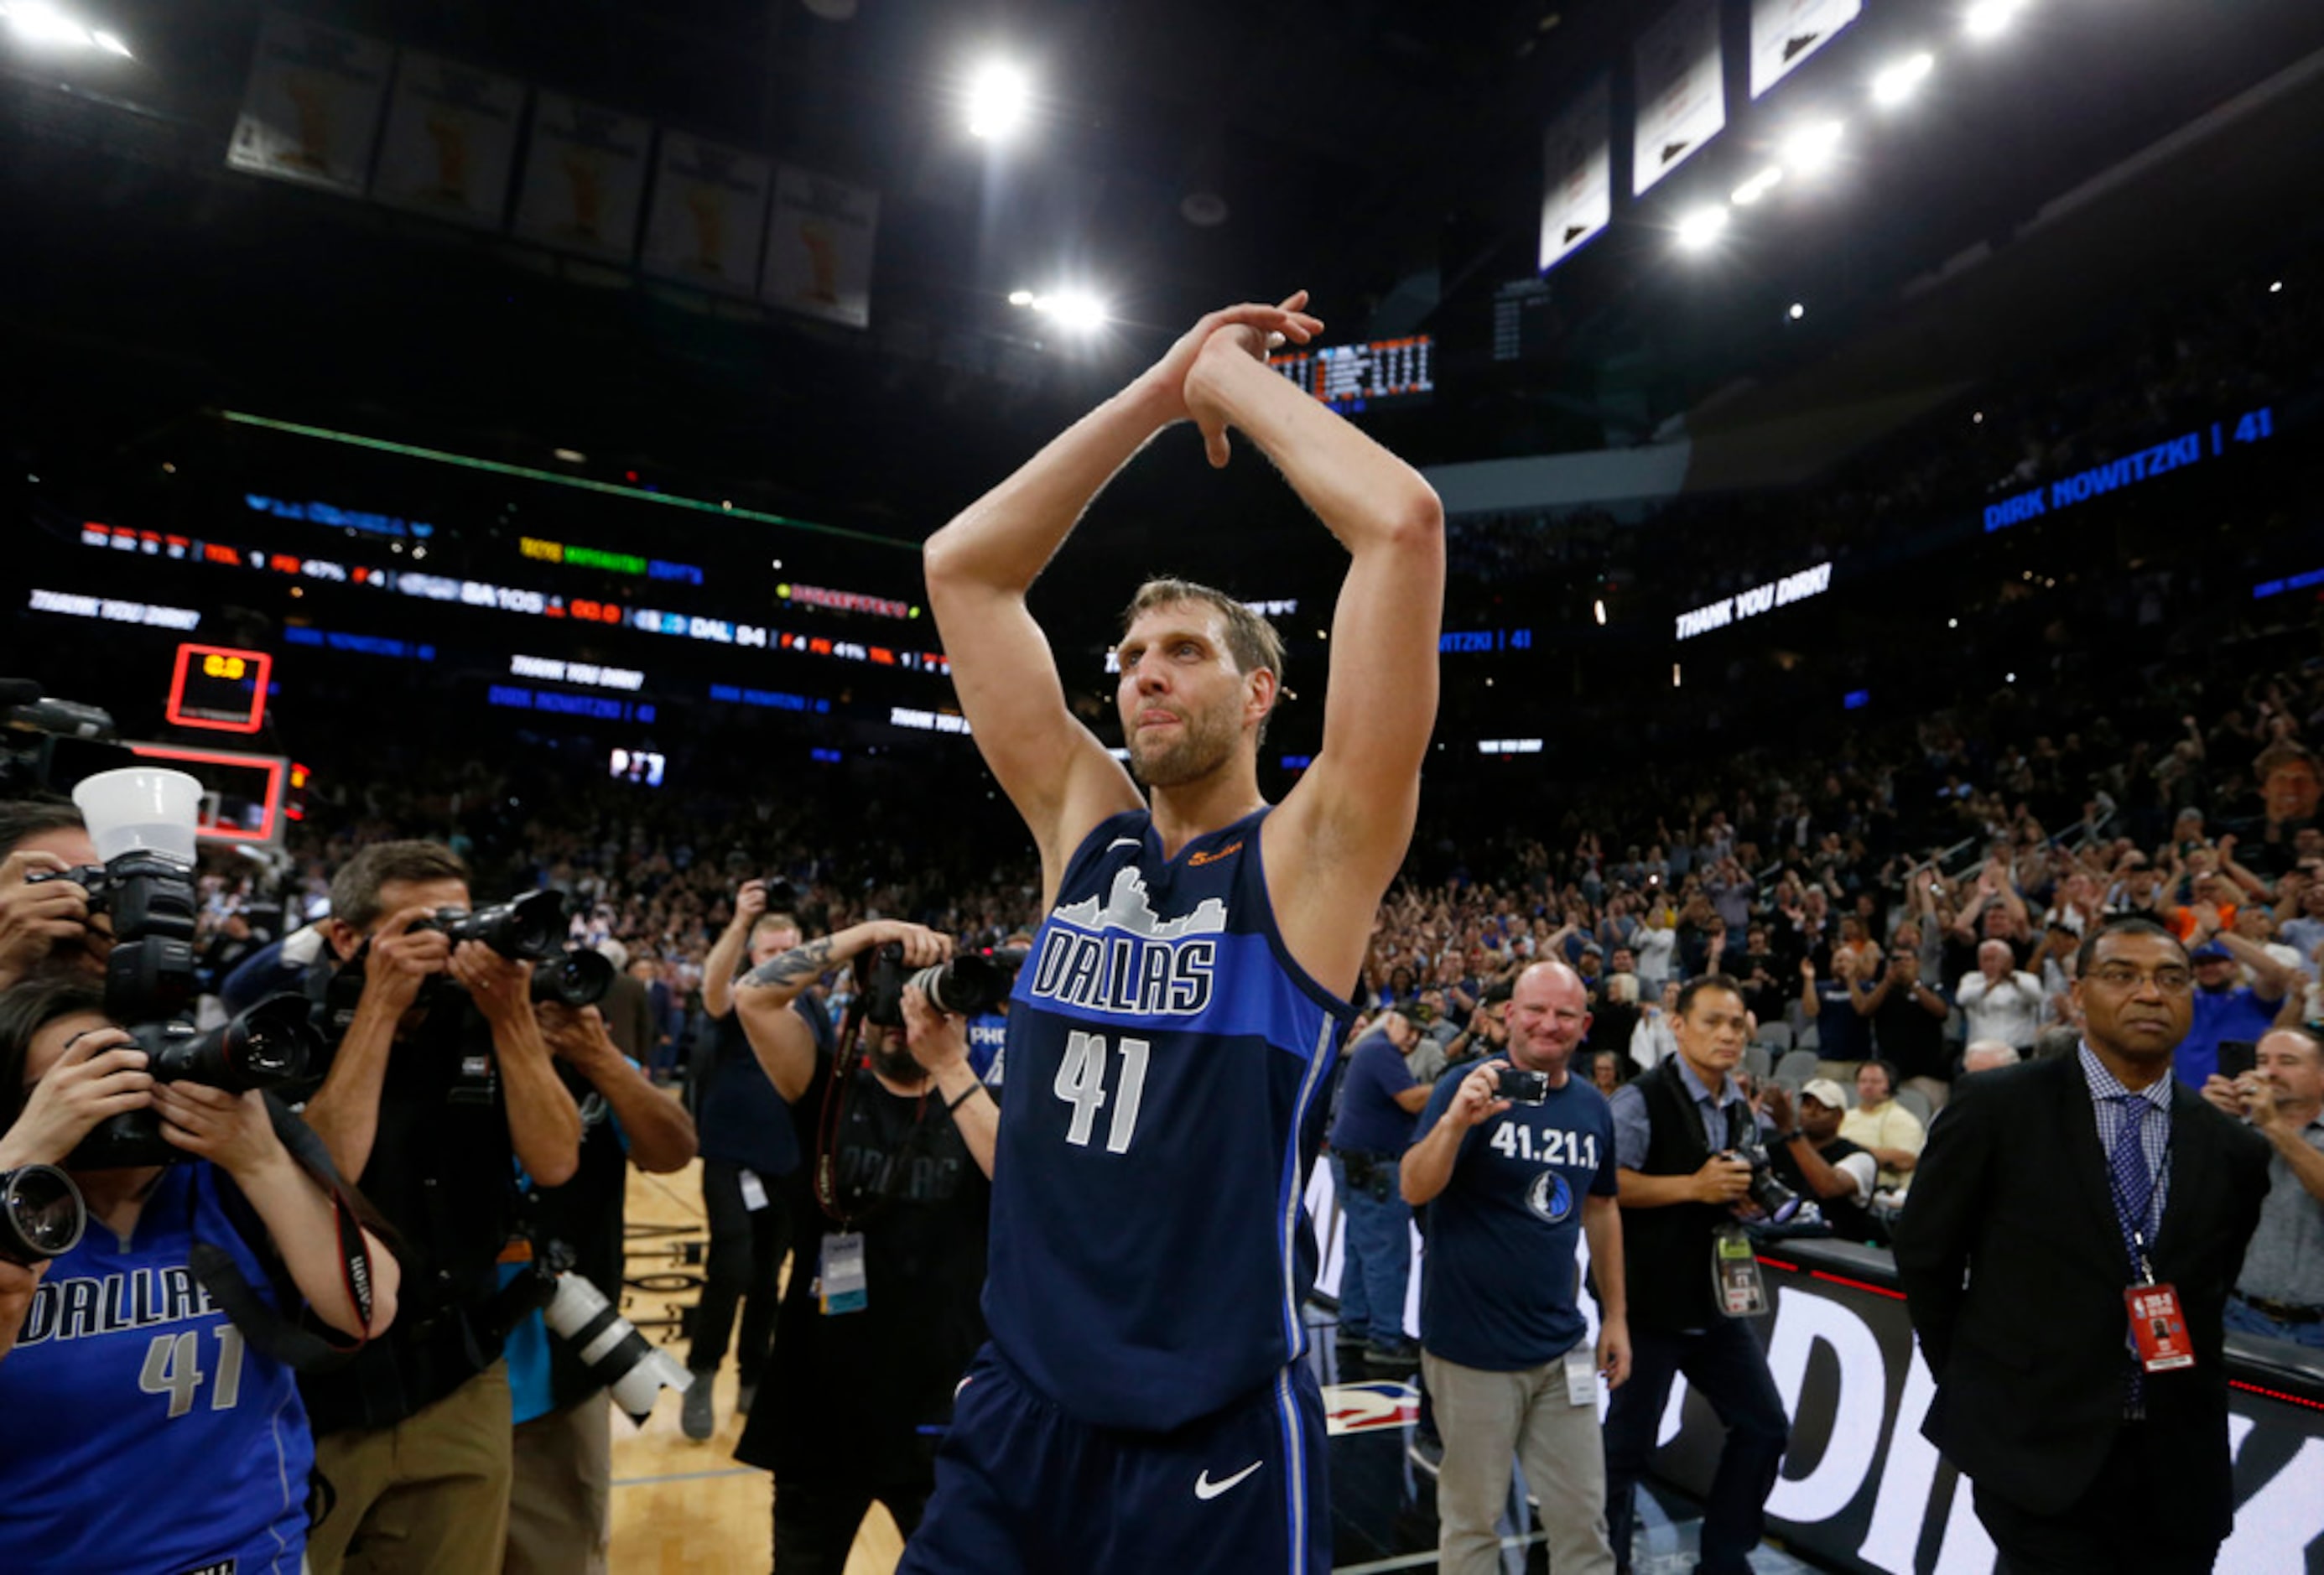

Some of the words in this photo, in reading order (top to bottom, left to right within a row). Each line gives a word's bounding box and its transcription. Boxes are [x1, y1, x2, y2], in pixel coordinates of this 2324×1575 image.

[1983, 487, 2046, 533] DIRK
[2051, 432, 2201, 509] NOWITZKI
[2233, 407, 2274, 443] 41
[689, 616, 734, 643] DAL
[1510, 629, 1531, 650] 41
[1677, 598, 1734, 641] THANK
[1735, 582, 1775, 620] YOU
[1031, 927, 1217, 1016] DALLAS
[1053, 1029, 1151, 1156] 41
[13, 1265, 226, 1350] DALLA
[138, 1323, 246, 1419] 41
